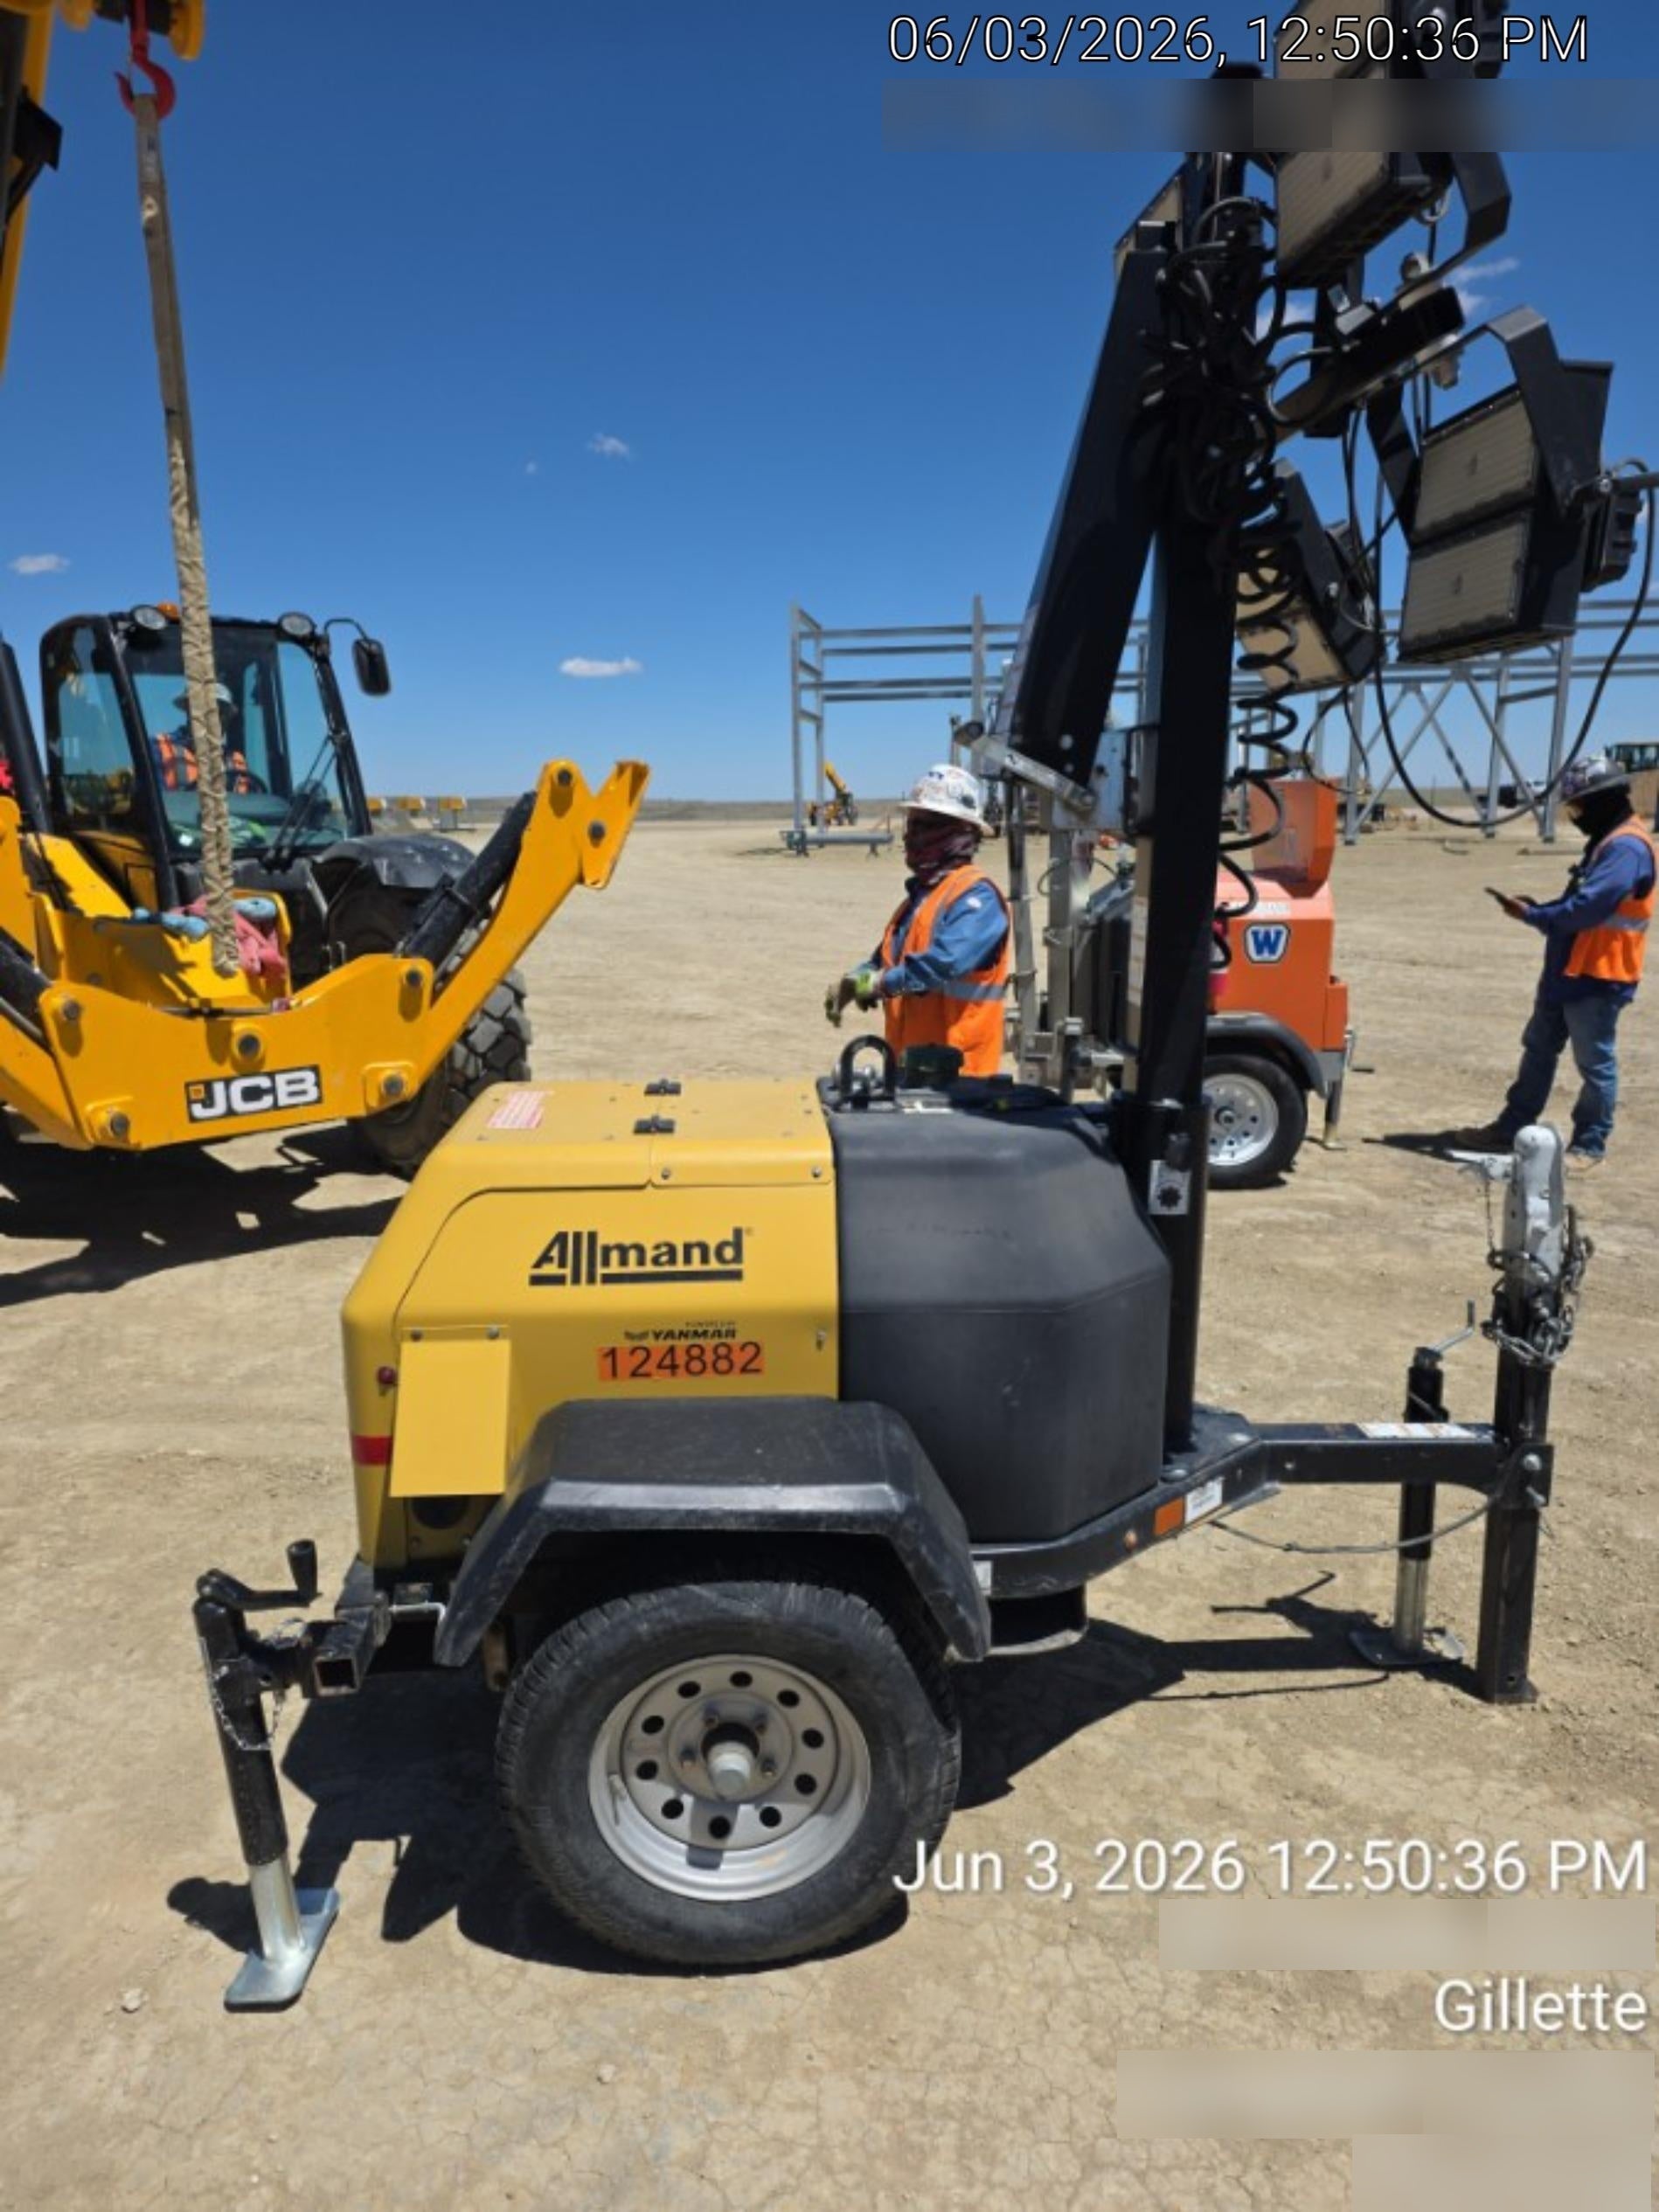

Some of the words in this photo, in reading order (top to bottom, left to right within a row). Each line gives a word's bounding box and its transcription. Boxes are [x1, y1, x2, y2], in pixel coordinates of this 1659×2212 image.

[1251, 929, 1284, 957] W
[189, 1069, 320, 1120] JCB
[530, 1226, 744, 1286] Allmand
[652, 1328, 736, 1341] YANMAR
[601, 1342, 763, 1378] 124882
